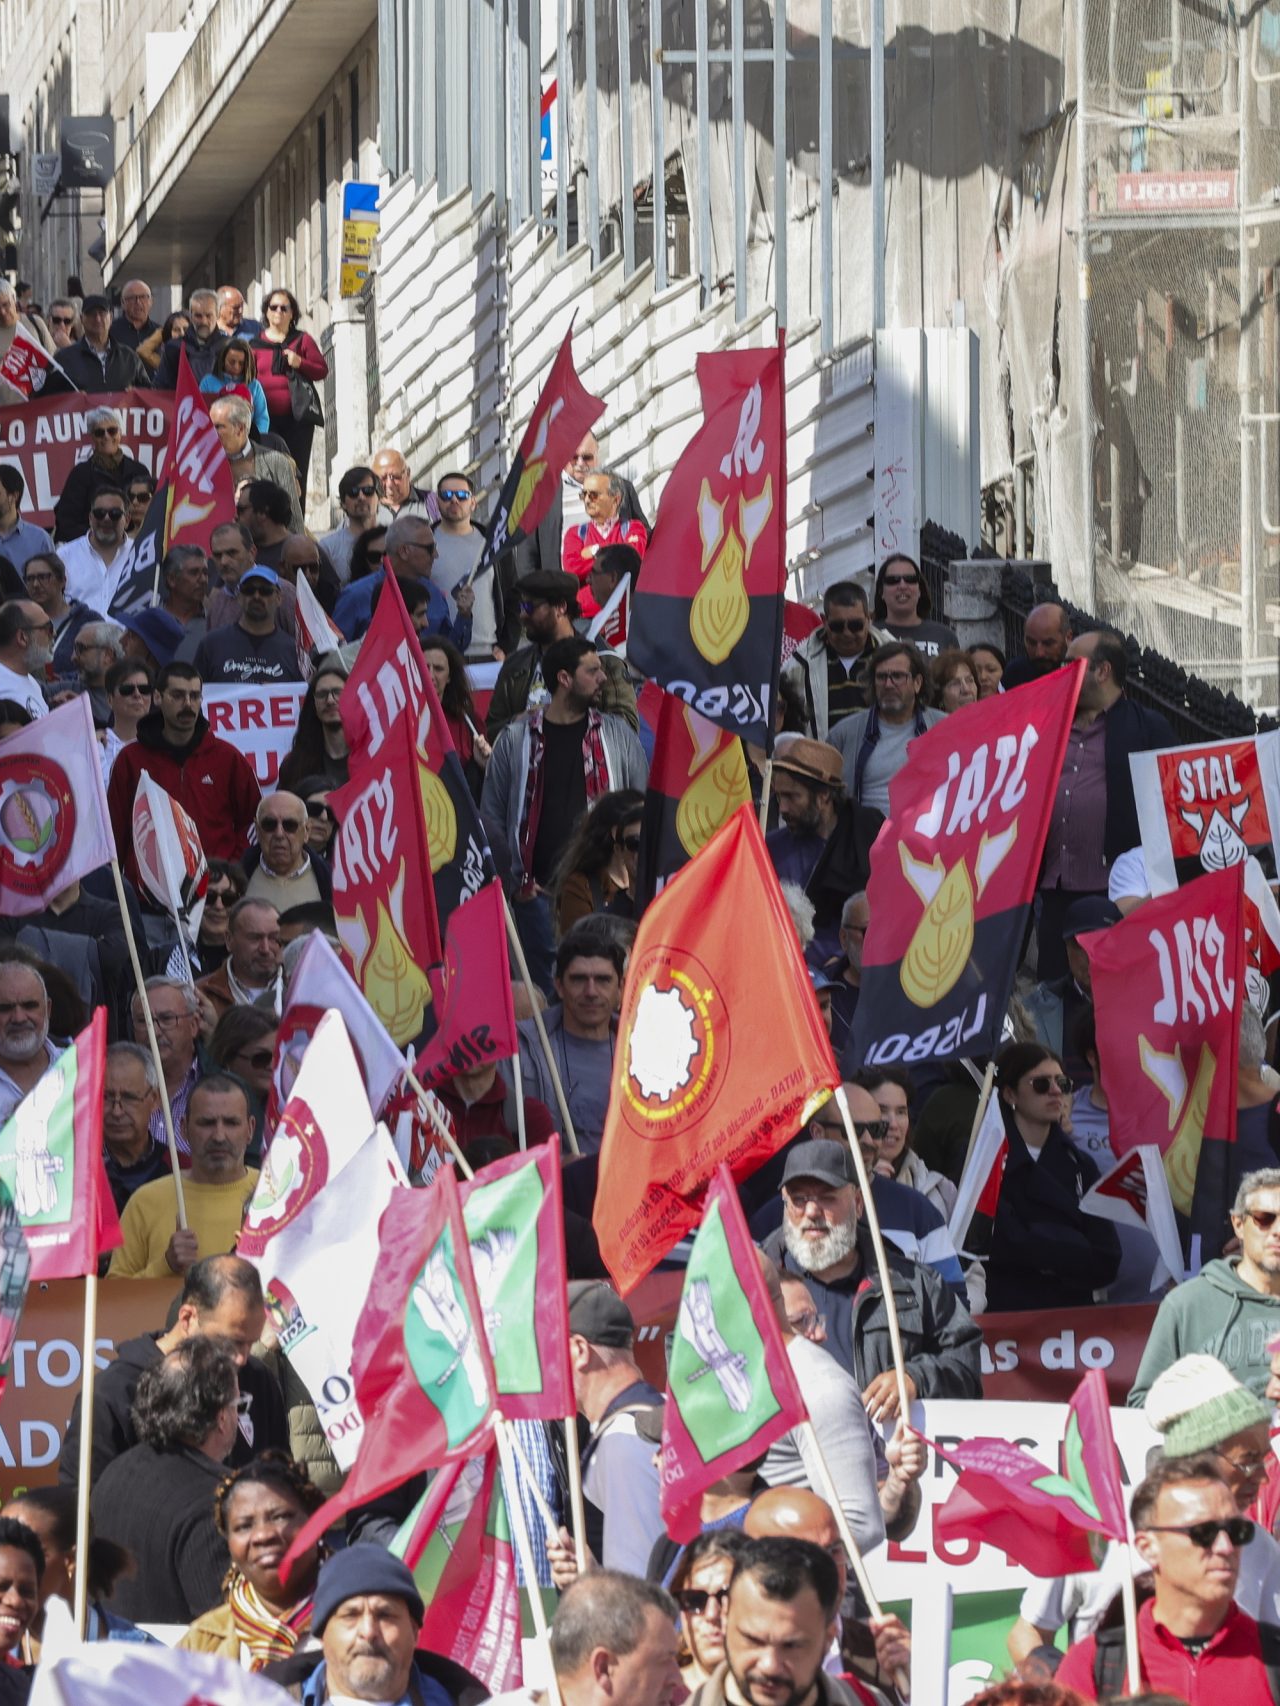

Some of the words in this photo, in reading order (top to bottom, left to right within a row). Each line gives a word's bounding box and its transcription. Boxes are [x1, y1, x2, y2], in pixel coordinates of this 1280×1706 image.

[35, 407, 165, 446] AUMNTO
[176, 396, 226, 494] STAL
[1178, 752, 1243, 803] STAL
[1040, 1330, 1115, 1370] do
